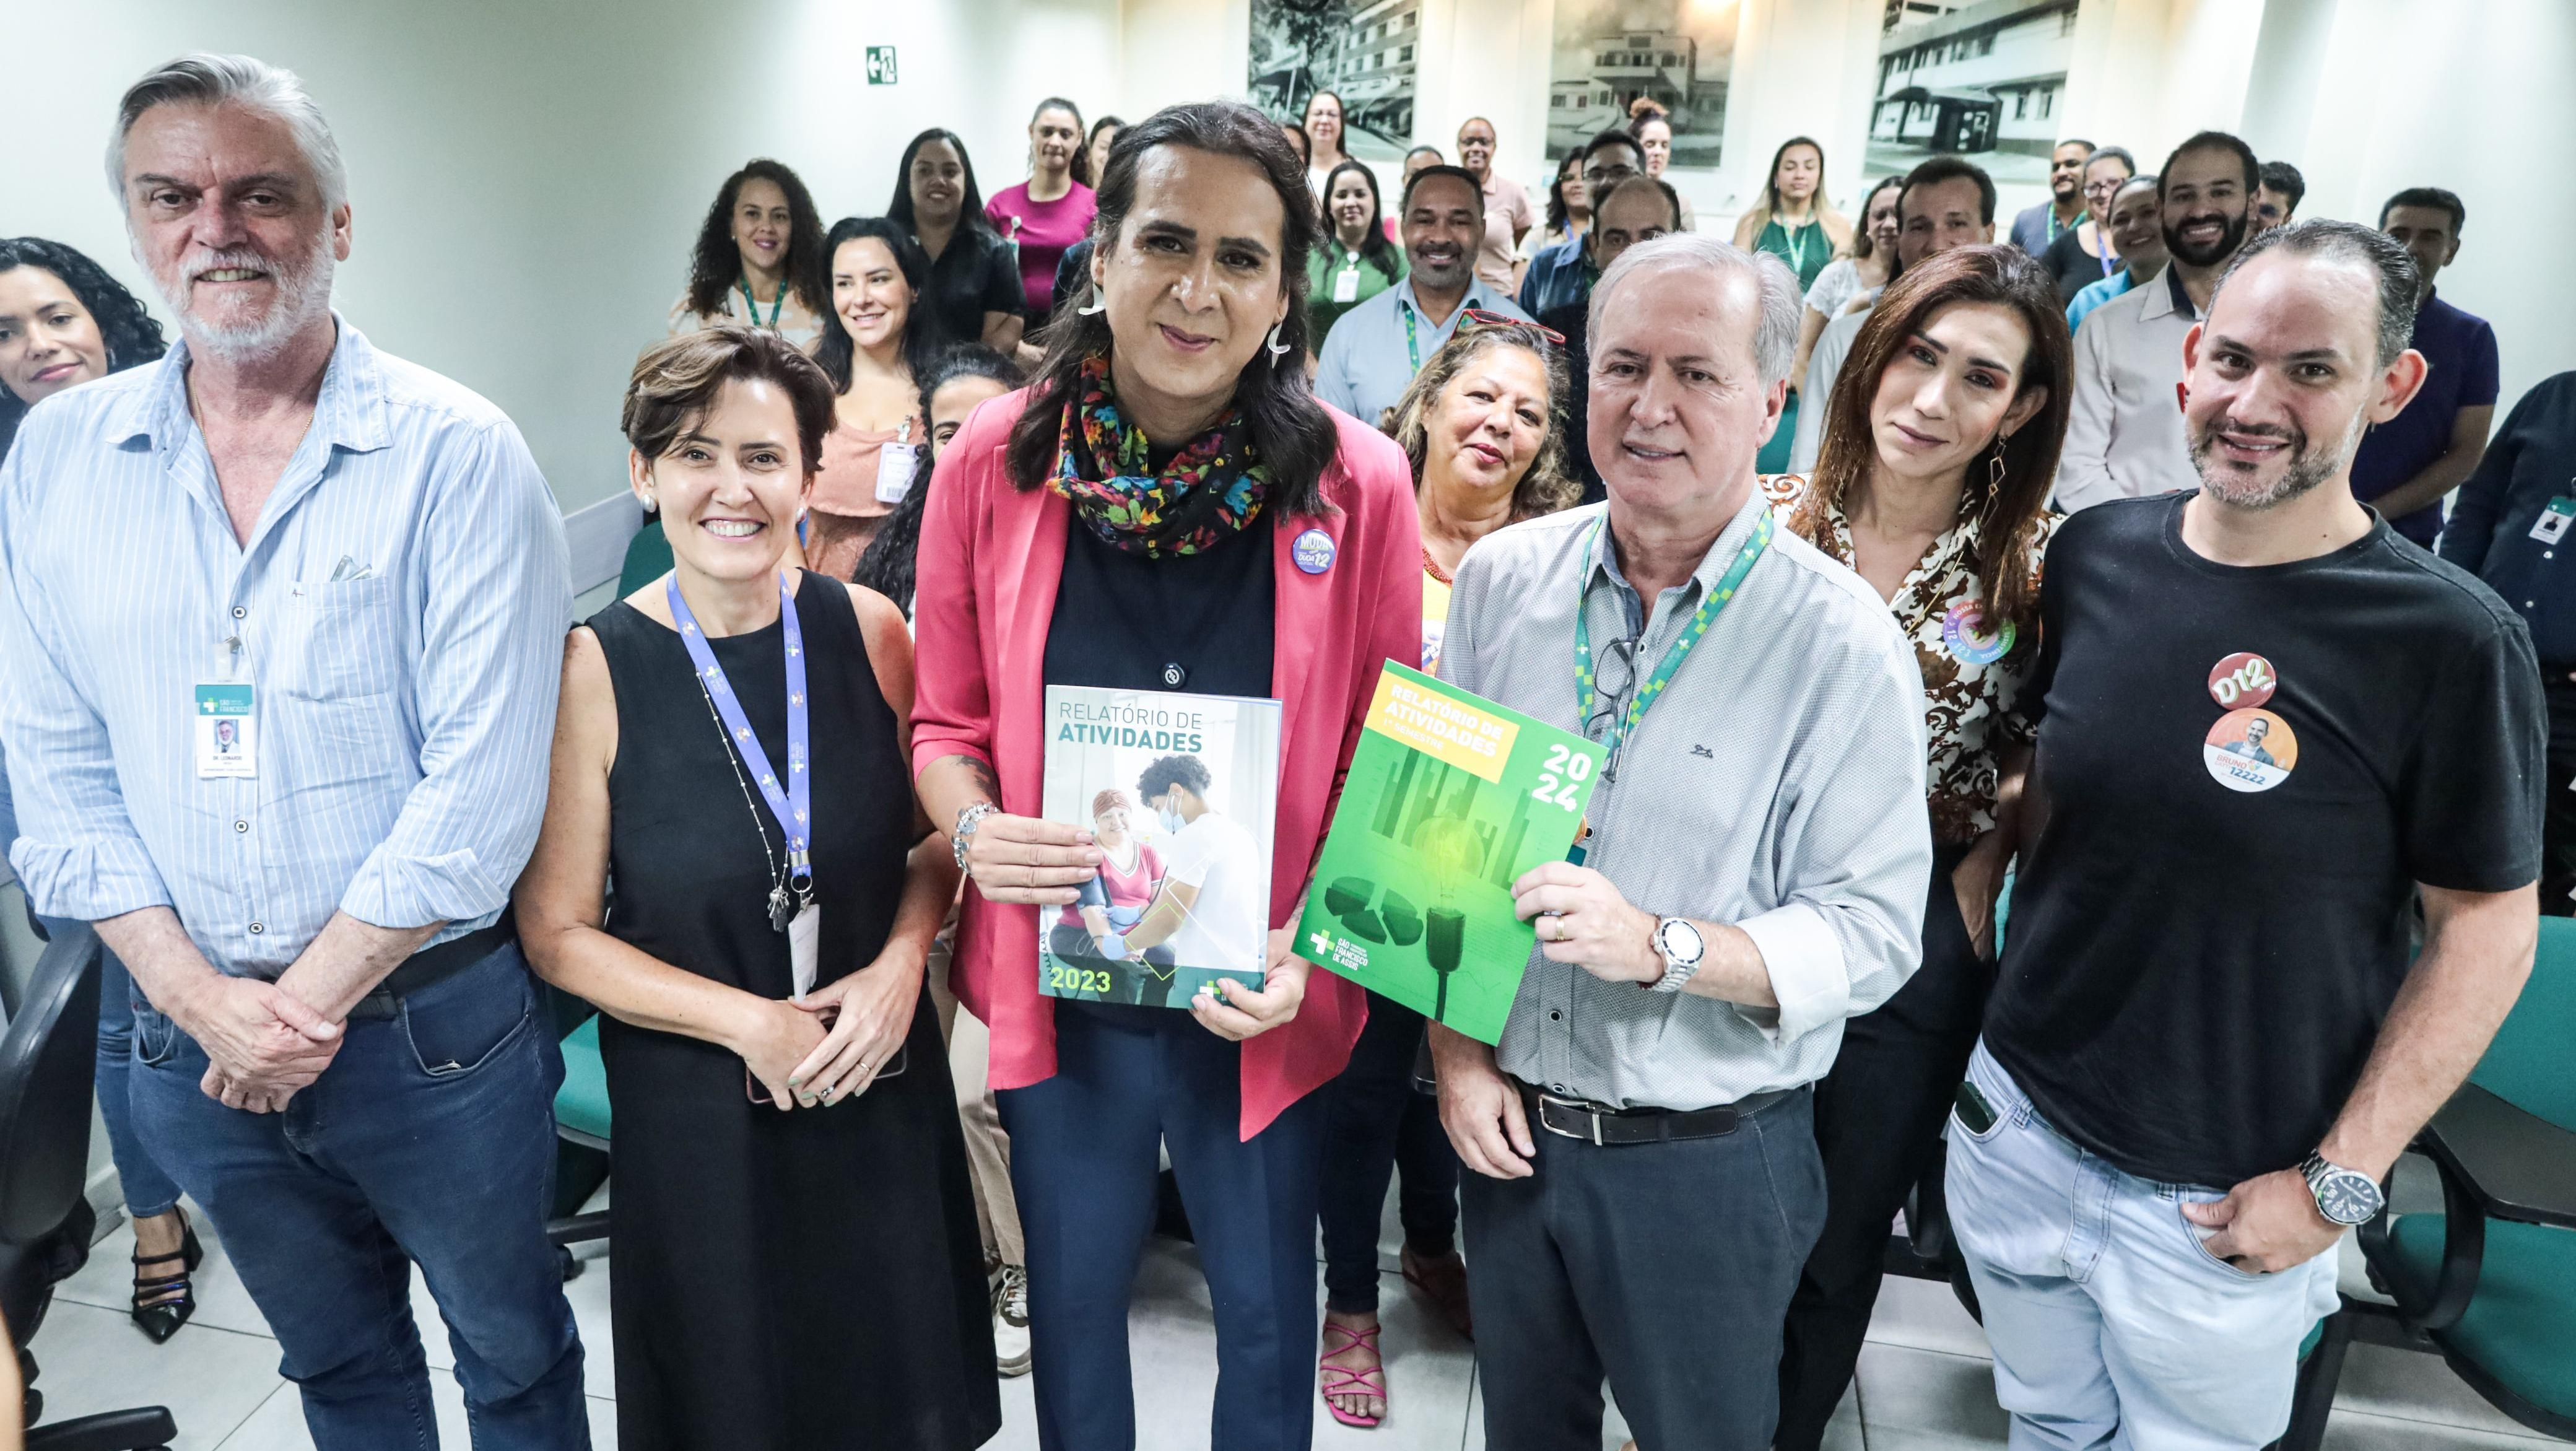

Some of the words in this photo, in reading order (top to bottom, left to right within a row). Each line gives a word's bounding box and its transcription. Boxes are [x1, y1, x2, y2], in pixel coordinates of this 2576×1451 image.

[1315, 552, 1330, 569] 12
[1952, 604, 1973, 619] NOSSA
[2211, 658, 2271, 704] D12
[1059, 701, 1169, 728] RELATÓRIO
[1177, 712, 1203, 730] DE
[1391, 684, 1478, 729] RELATÓRIO
[1480, 721, 1504, 739] DE
[1058, 723, 1203, 752] ATIVIDADES
[1385, 701, 1497, 757] ATIVIDADES
[1395, 722, 1445, 751] SEMESTRE
[1543, 743, 1592, 781] 20
[2217, 754, 2247, 769] BRUNO
[2229, 767, 2266, 785] 12222
[1531, 773, 1580, 813] 24
[1334, 945, 1368, 966] FRANCISCO
[1338, 938, 1350, 949] SÃO
[1332, 953, 1341, 963] DE
[1340, 957, 1359, 971] ASSIS
[1050, 966, 1111, 993] 2023
